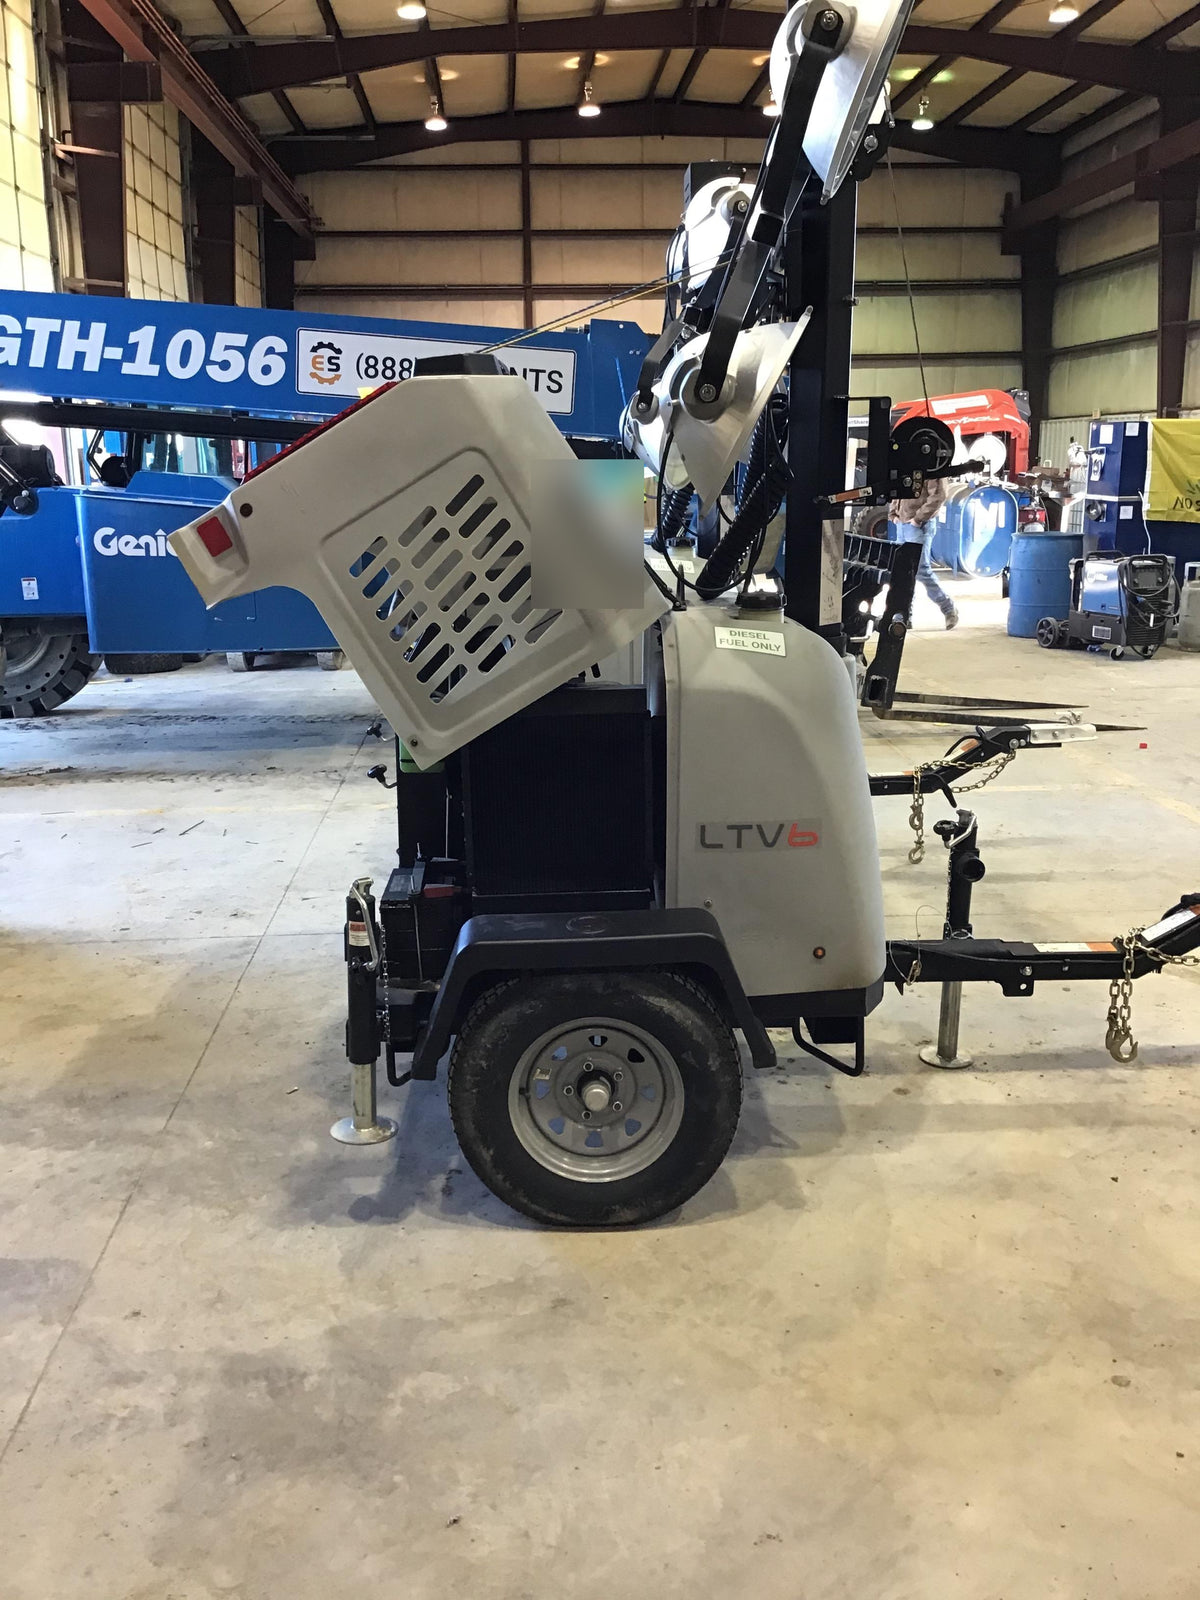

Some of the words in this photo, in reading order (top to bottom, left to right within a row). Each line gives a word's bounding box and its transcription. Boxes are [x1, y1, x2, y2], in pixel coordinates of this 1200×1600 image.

[0, 314, 288, 386] GTH-1056
[312, 354, 340, 372] ES
[356, 352, 419, 380] (888
[1172, 496, 1193, 510] NO
[729, 630, 770, 641] DIESEL
[719, 638, 748, 647] FUEL
[751, 641, 781, 652] ONLY
